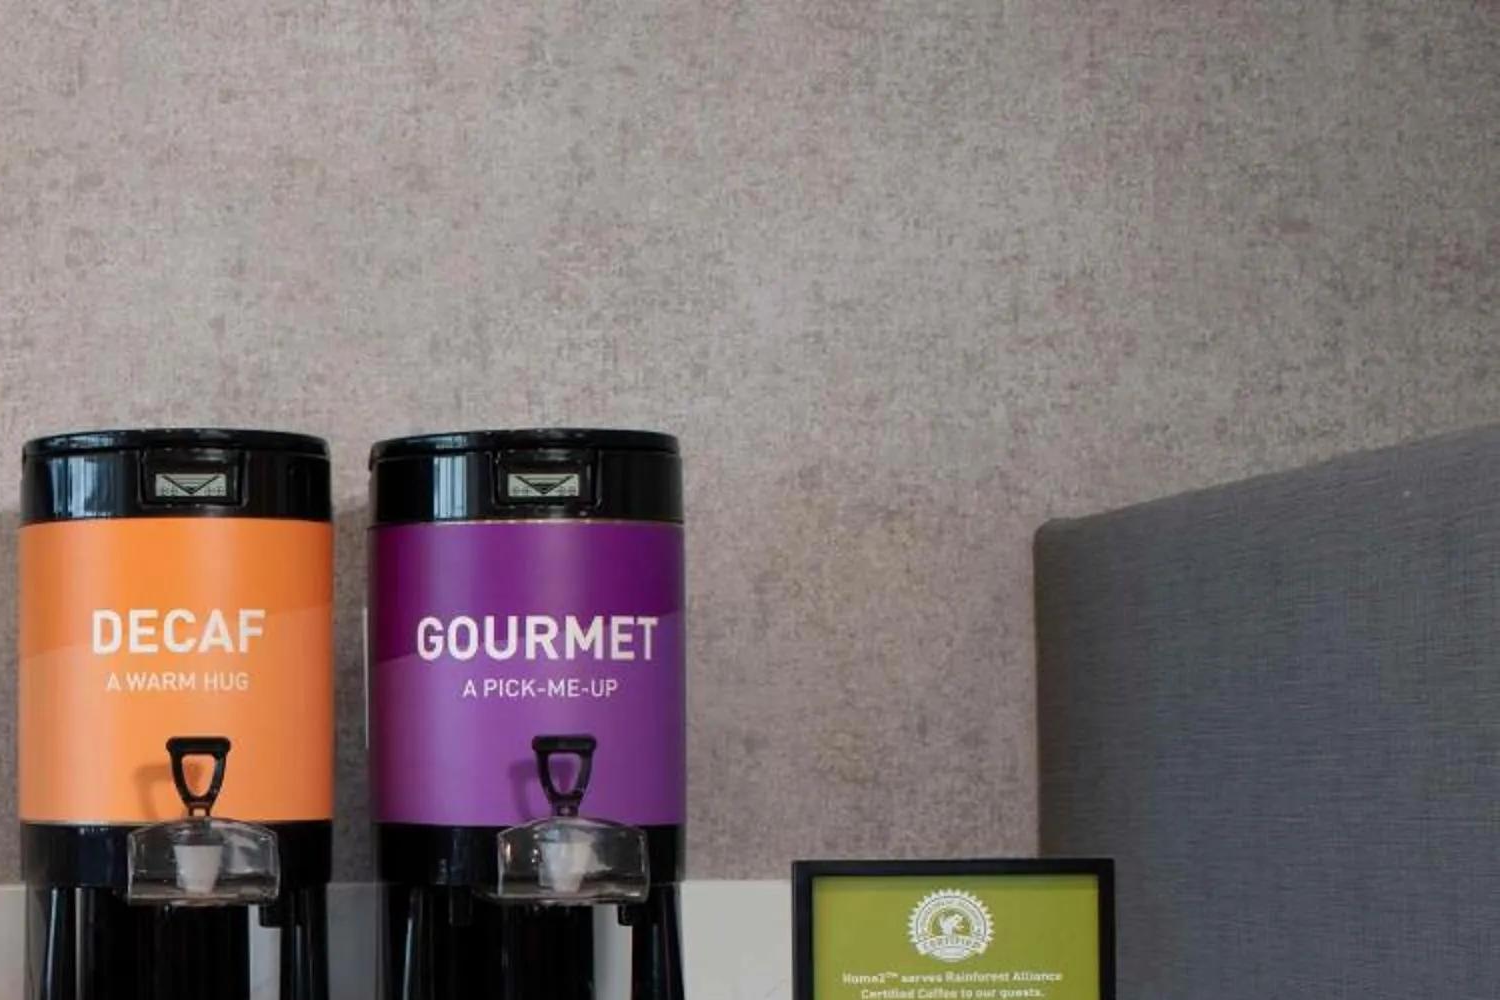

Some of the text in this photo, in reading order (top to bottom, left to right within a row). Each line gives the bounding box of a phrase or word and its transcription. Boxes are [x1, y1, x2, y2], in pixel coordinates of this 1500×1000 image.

[91, 609, 265, 655] DECAF
[416, 615, 659, 661] GOURMET
[105, 672, 249, 691] A WARM HUG
[462, 678, 618, 698] A PICK-ME-UP
[945, 970, 1009, 982] Rainforest
[1012, 970, 1063, 982] Alliance
[861, 988, 915, 1000] Certified
[917, 987, 958, 1000] Coffee
[960, 988, 973, 999] to
[975, 989, 996, 999] our
